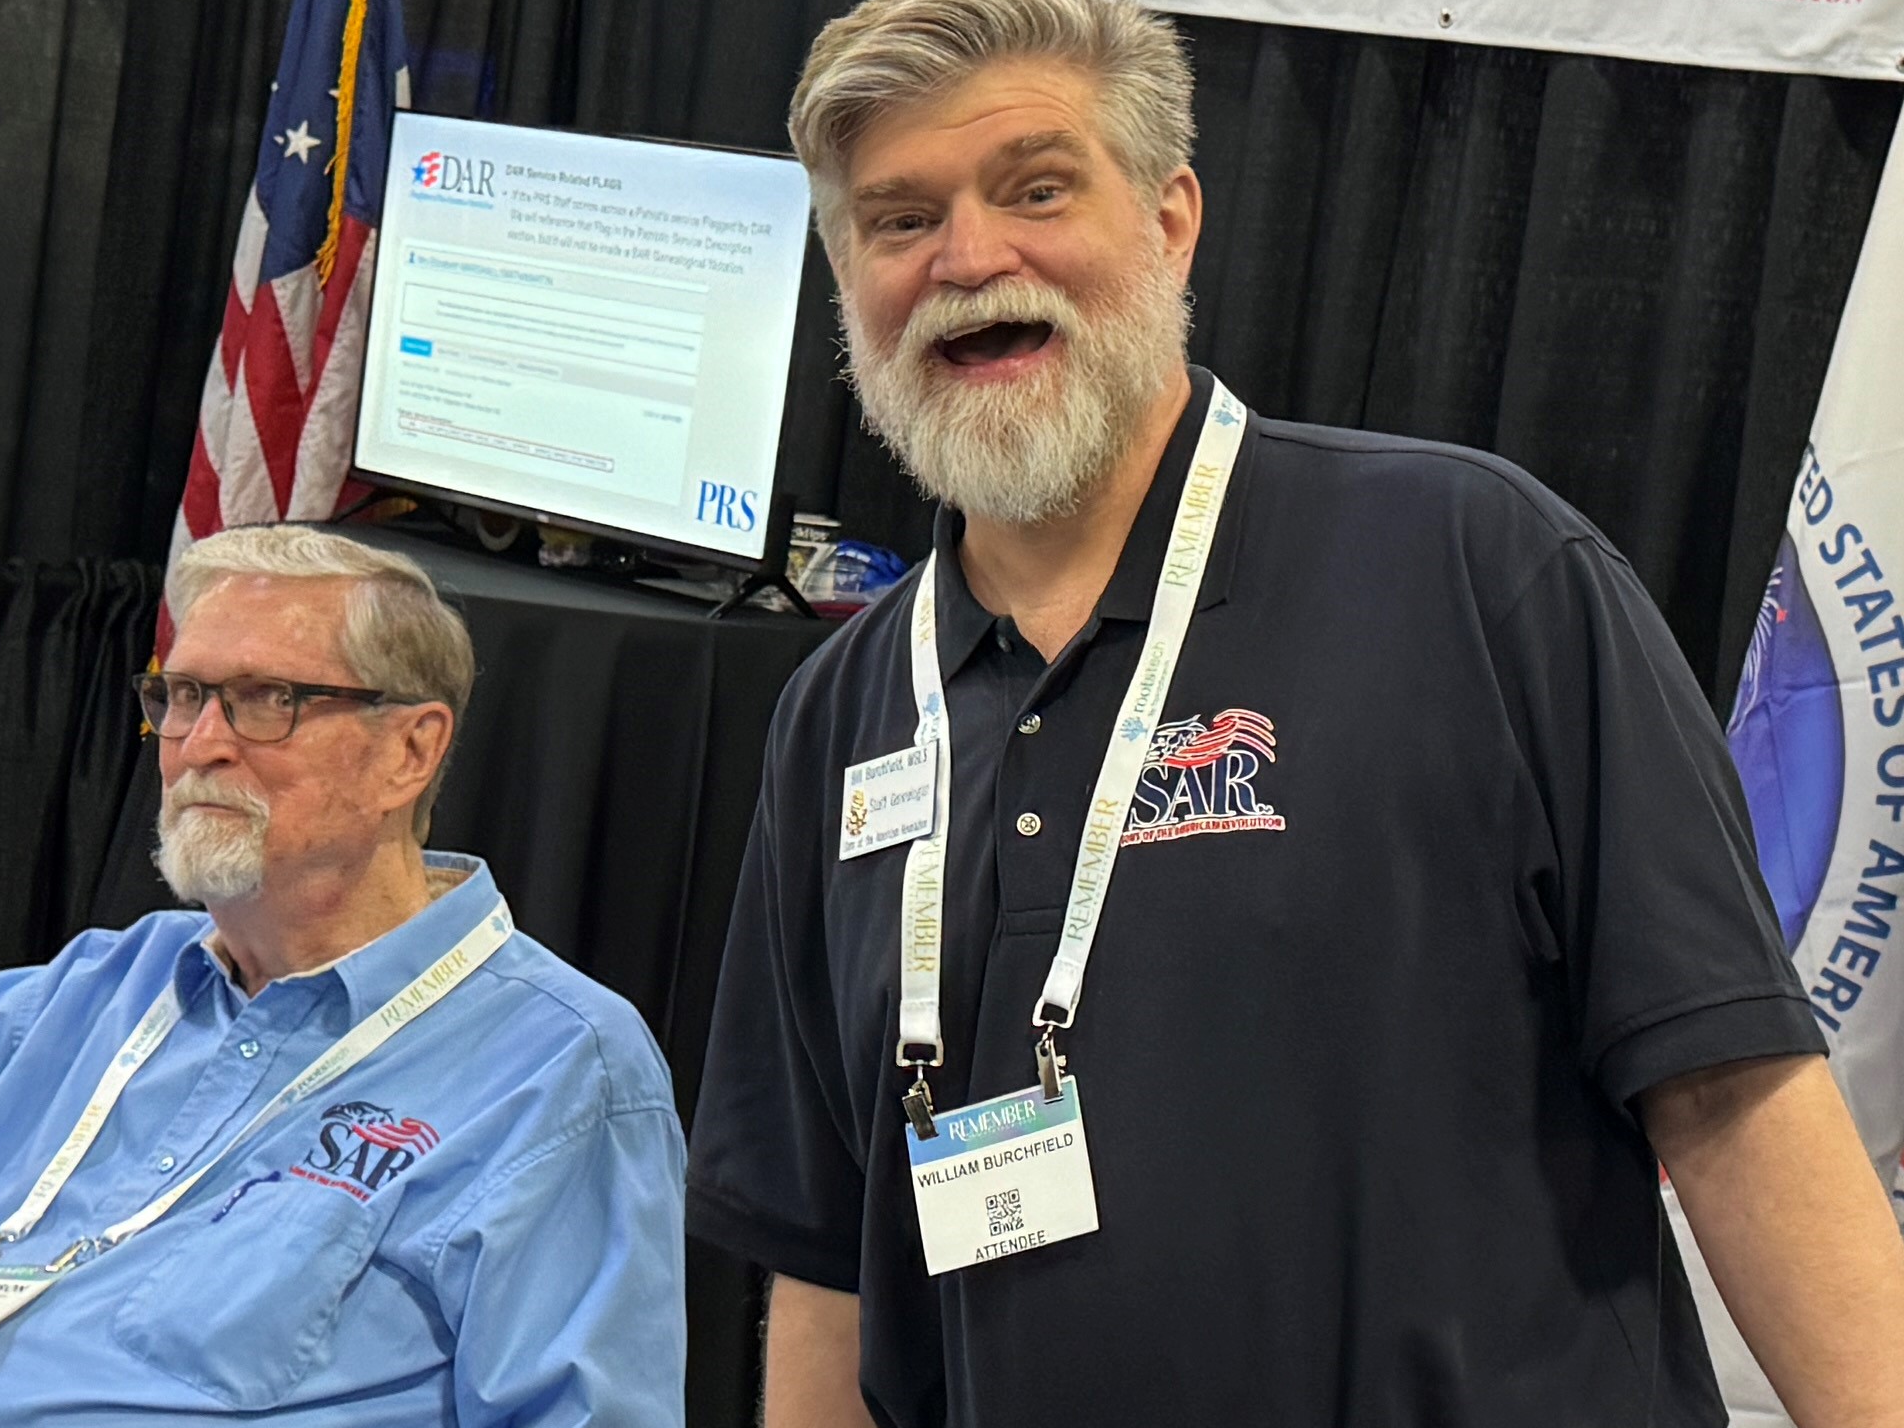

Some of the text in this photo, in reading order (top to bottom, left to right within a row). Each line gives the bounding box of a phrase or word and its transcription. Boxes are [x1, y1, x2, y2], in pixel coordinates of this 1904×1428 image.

[441, 155, 495, 197] DAR
[696, 480, 758, 532] PRS
[1164, 463, 1220, 589] REMEMBER
[1133, 640, 1167, 714] rootstech
[1128, 750, 1262, 831] SAR
[1066, 797, 1119, 942] REMEMBER
[949, 1099, 1037, 1142] REMEMBER
[917, 1132, 1074, 1189] WILLIAM BURCHFIELD
[975, 1229, 1047, 1263] ATTENDEE
